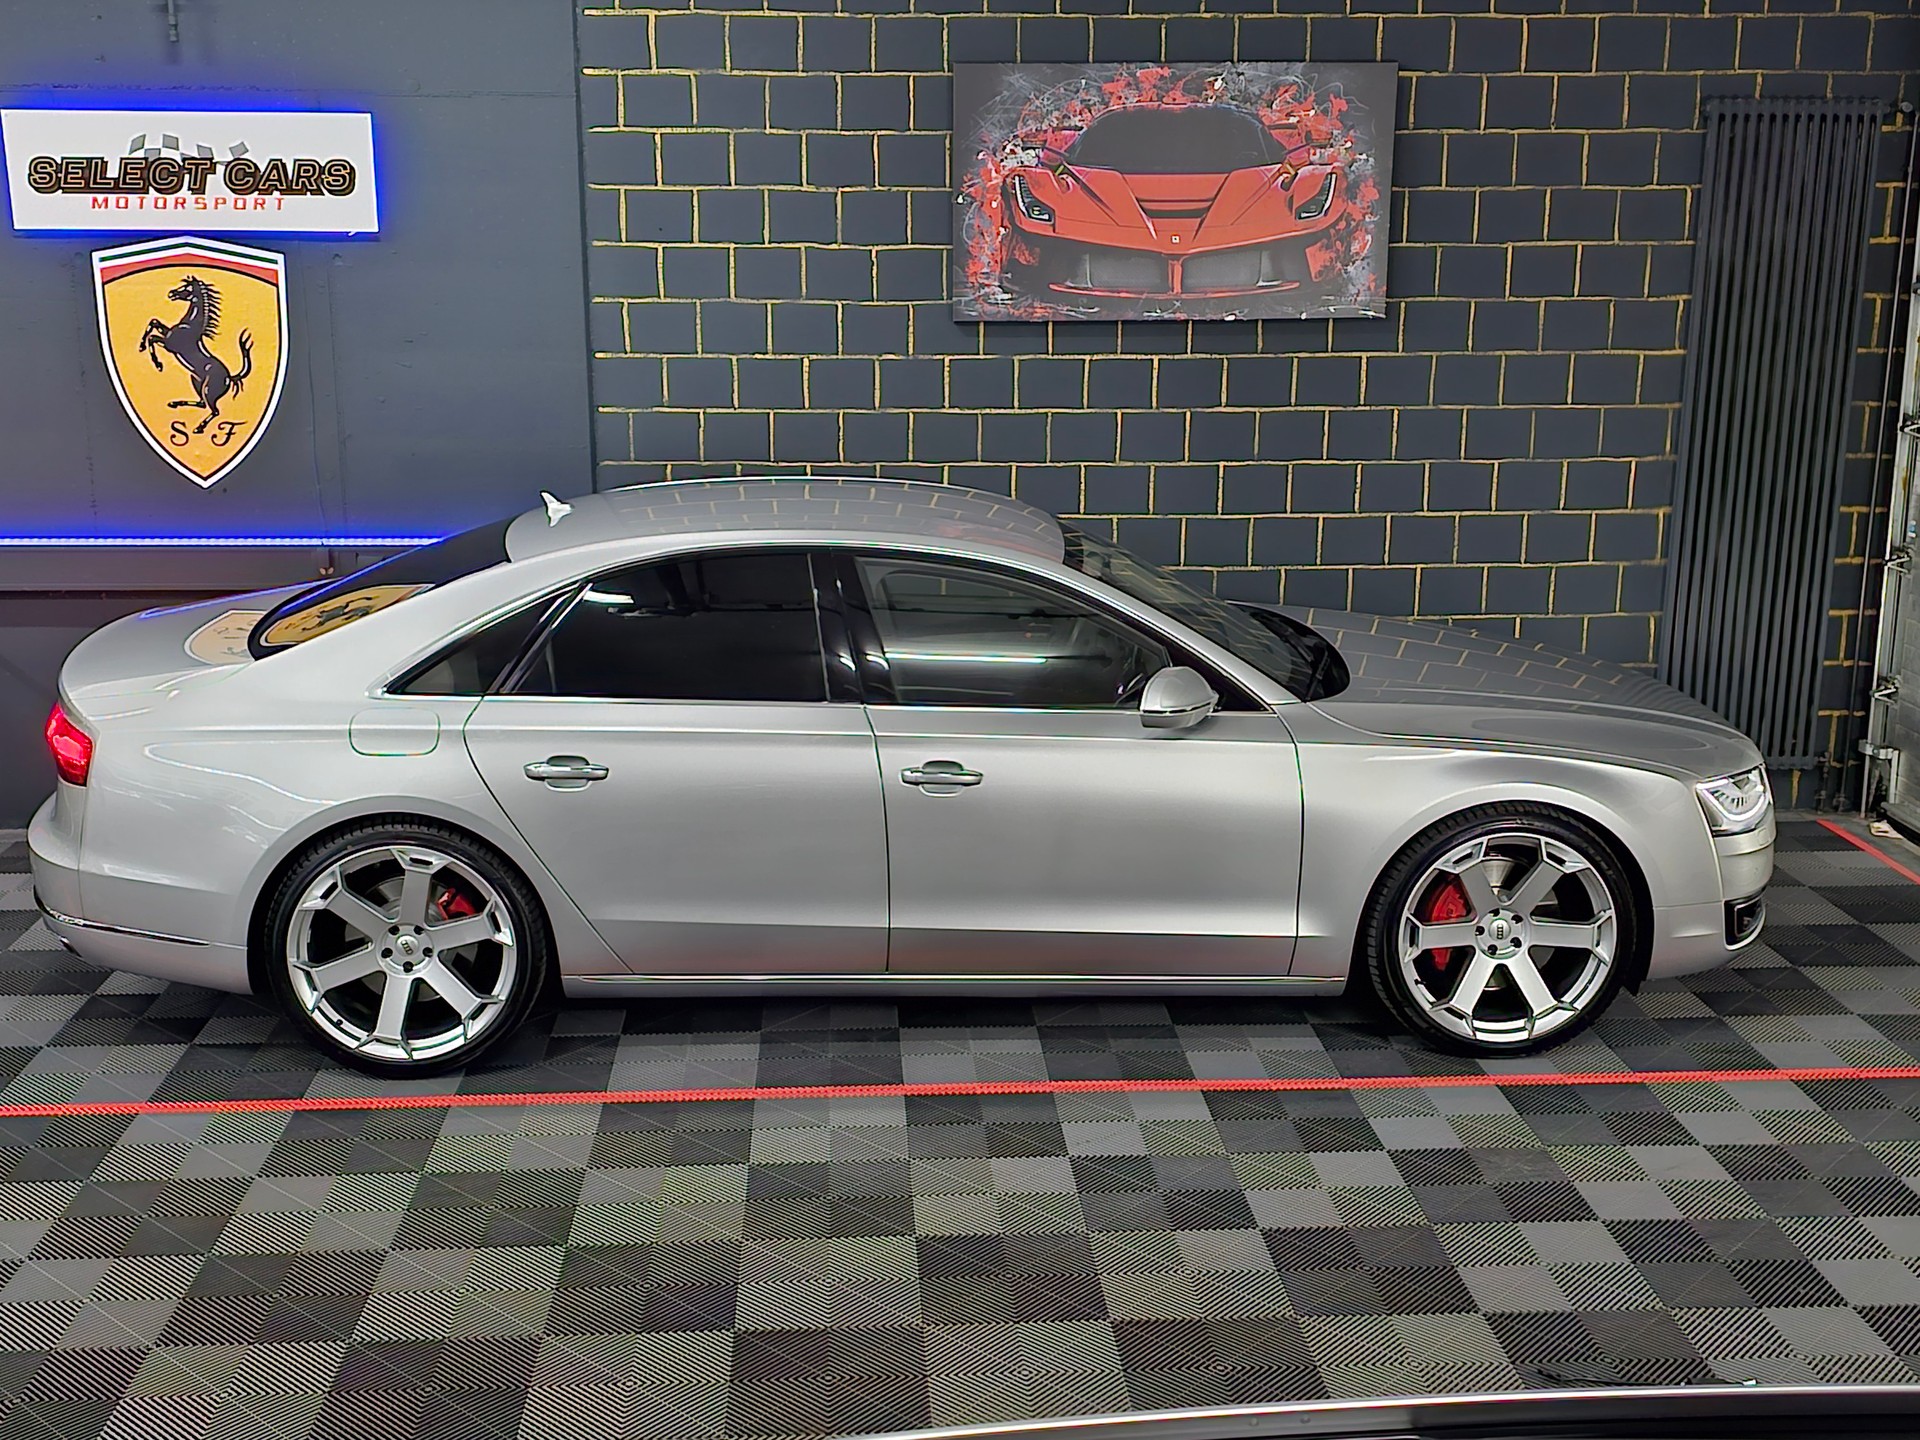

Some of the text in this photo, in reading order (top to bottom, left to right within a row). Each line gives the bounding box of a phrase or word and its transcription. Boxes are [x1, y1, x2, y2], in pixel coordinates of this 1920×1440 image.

[28, 156, 356, 196] SELECT CARS
[91, 196, 286, 210] MOTORSPORT
[170, 420, 248, 447] S F
